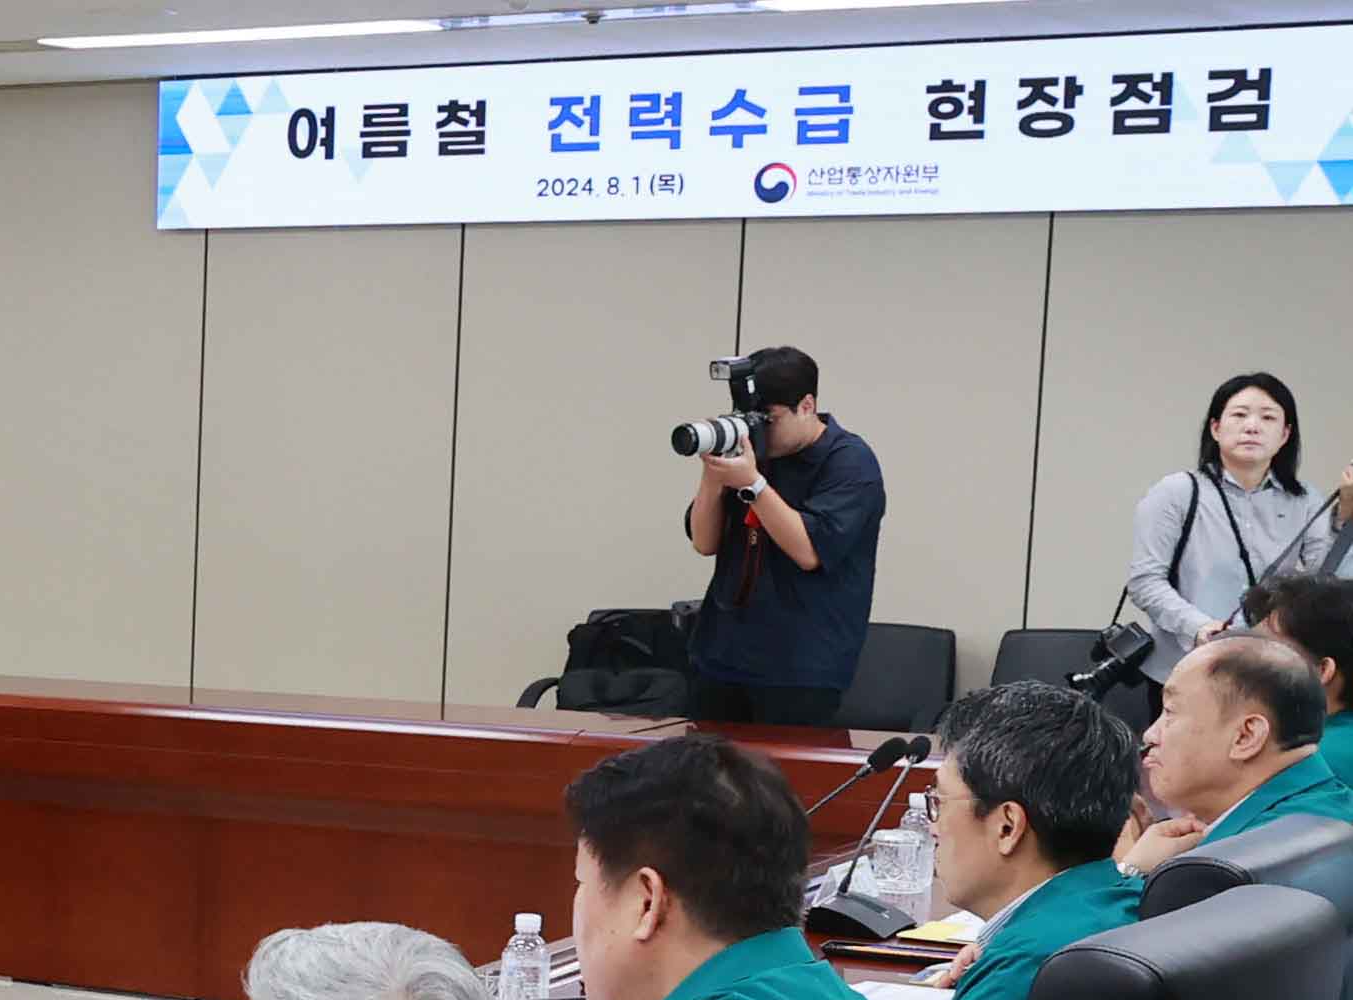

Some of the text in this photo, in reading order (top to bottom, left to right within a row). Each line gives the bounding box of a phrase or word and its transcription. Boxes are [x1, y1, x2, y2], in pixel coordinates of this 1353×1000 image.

[287, 67, 1273, 160] 여름철 전력수급 현장점검
[808, 164, 940, 185] 산업통상자원부
[537, 177, 599, 198] 2024.
